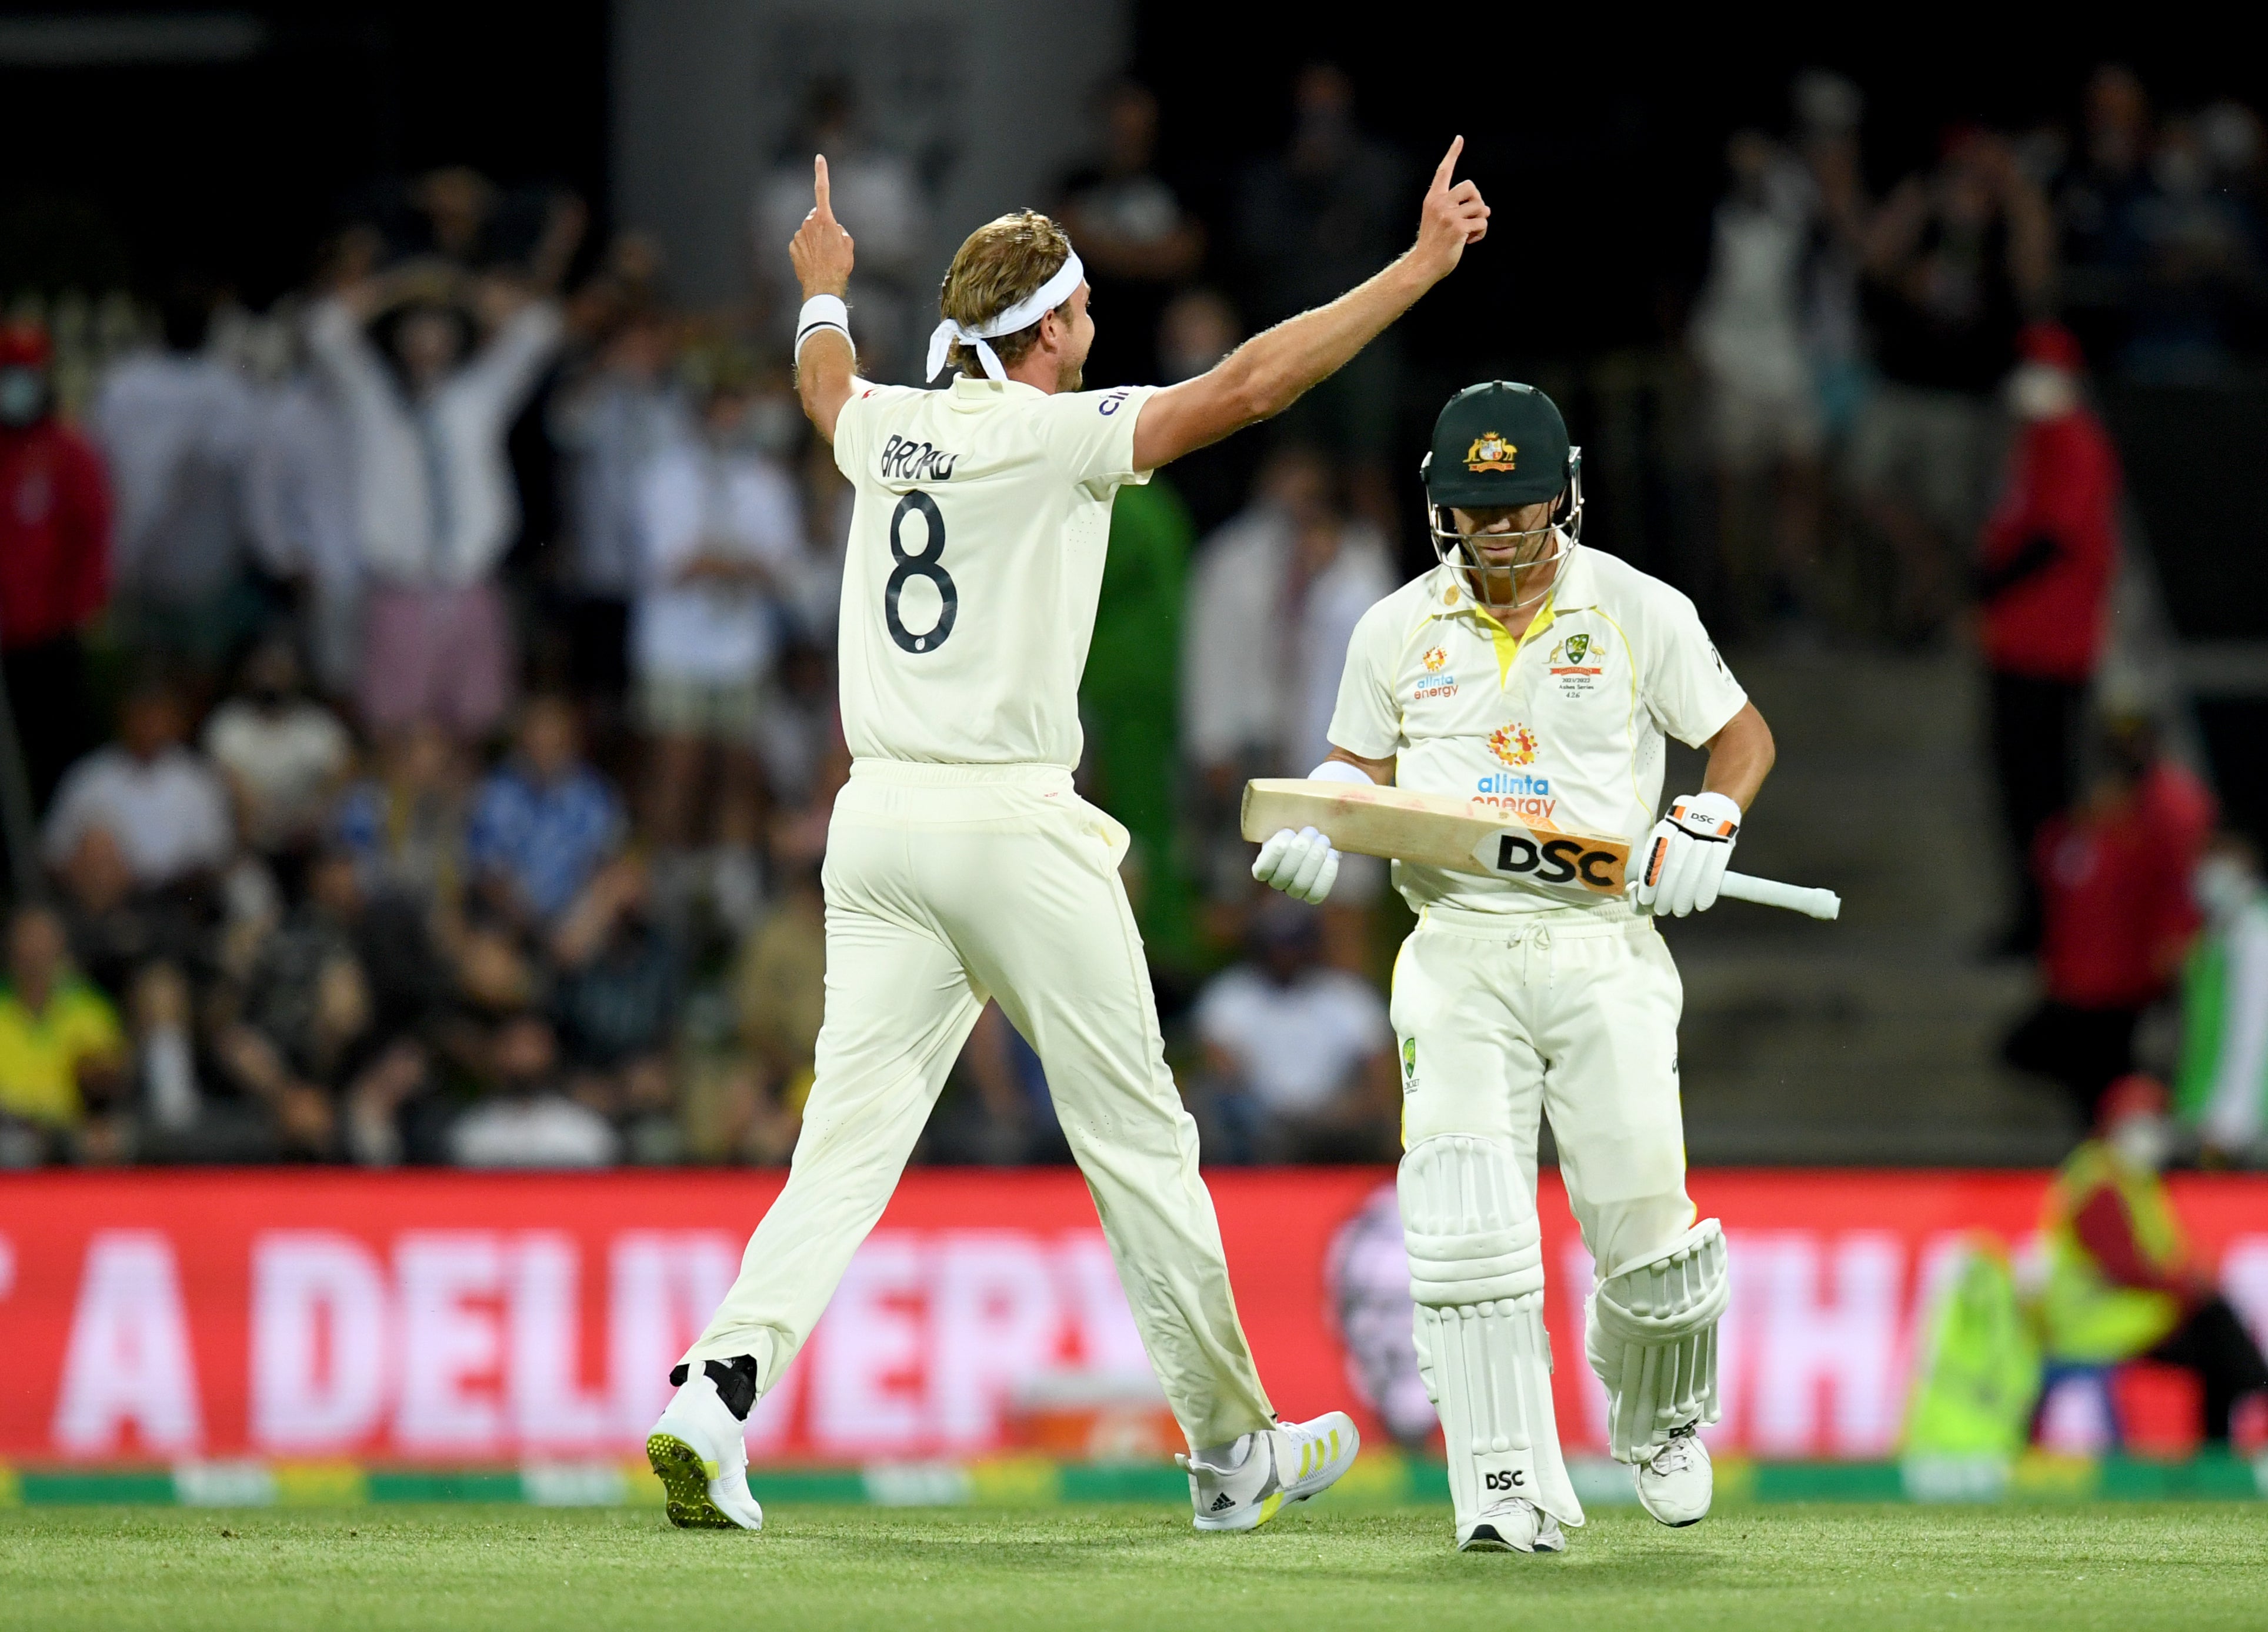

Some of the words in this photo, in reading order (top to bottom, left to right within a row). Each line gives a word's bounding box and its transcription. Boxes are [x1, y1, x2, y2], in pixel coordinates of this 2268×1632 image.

[881, 434, 961, 481] BROAD
[885, 489, 958, 654] 8
[1413, 684, 1459, 700] energy
[1417, 674, 1454, 689] alinta
[1477, 773, 1549, 795] alinta
[1690, 812, 1715, 825] DSC
[1496, 834, 1619, 887] DSC
[53, 1230, 203, 1454] A
[1485, 1470, 1525, 1490] DSC
